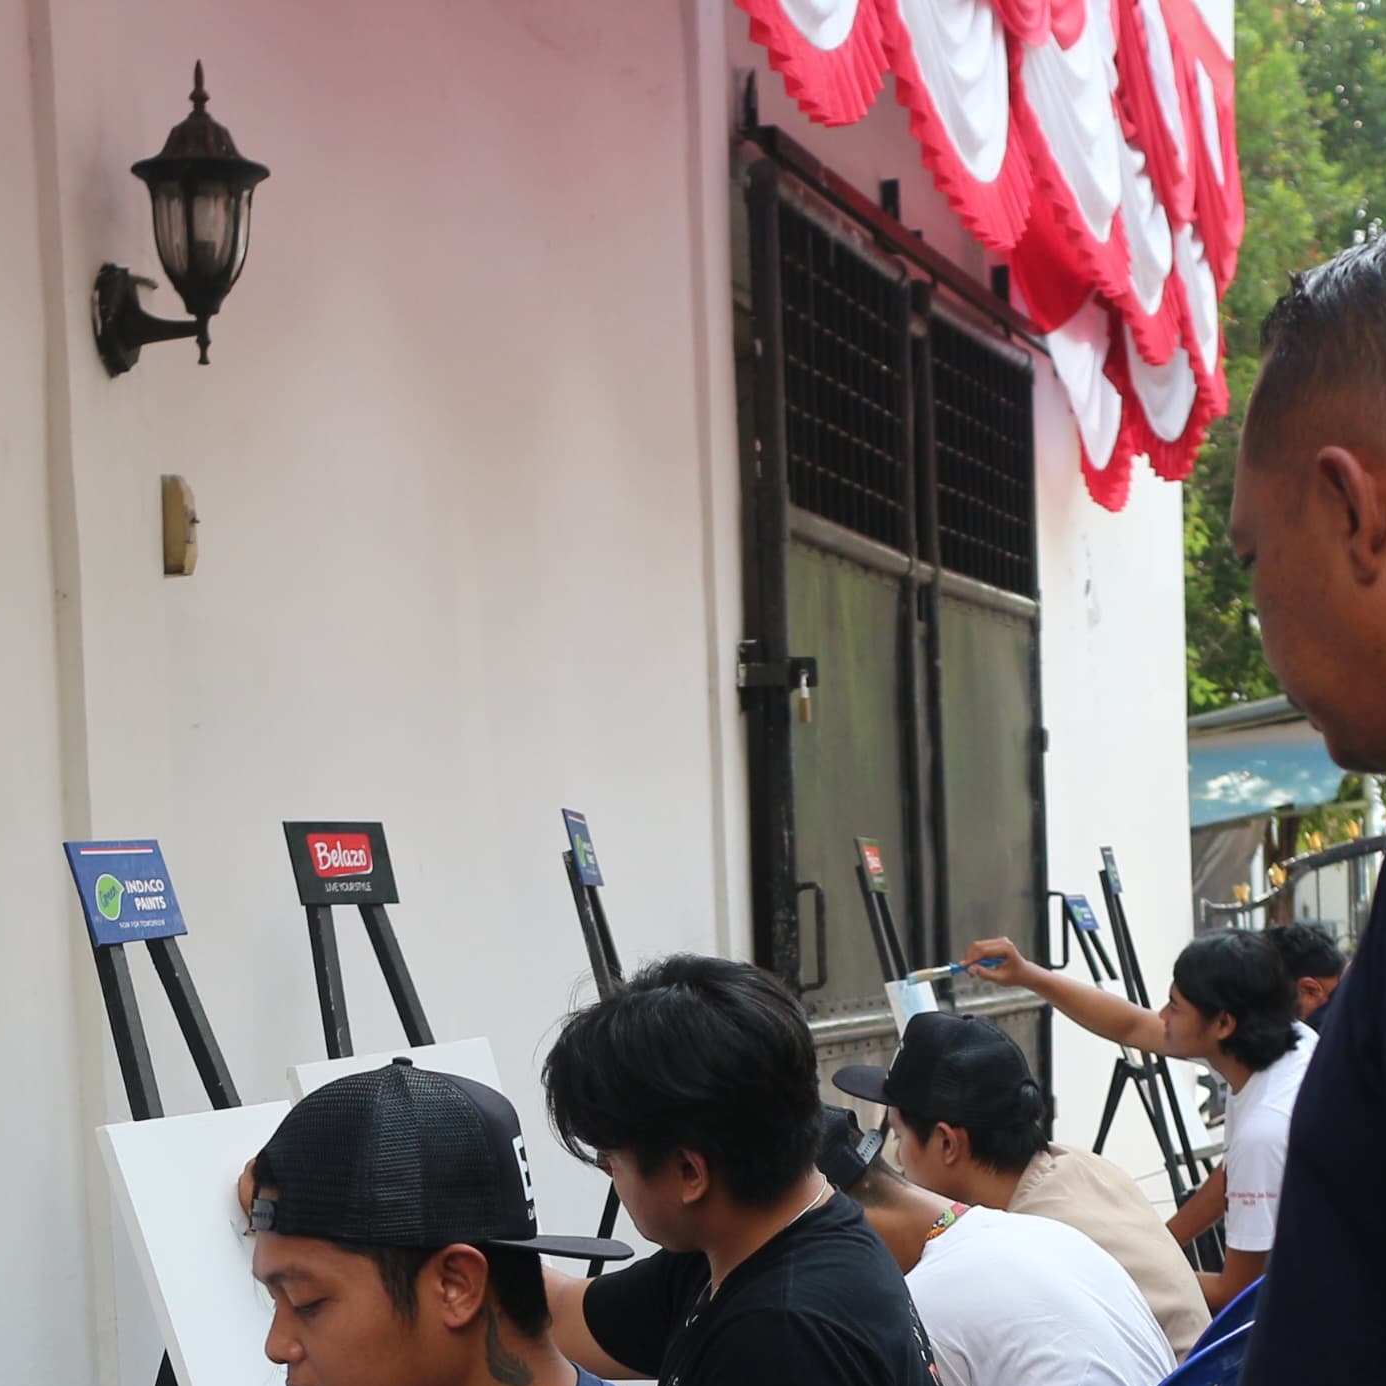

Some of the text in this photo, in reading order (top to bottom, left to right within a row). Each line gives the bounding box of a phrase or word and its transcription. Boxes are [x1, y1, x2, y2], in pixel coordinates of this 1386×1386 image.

[314, 840, 367, 870] Belazo
[124, 878, 165, 894] INDACO
[134, 895, 167, 912] PAINTS
